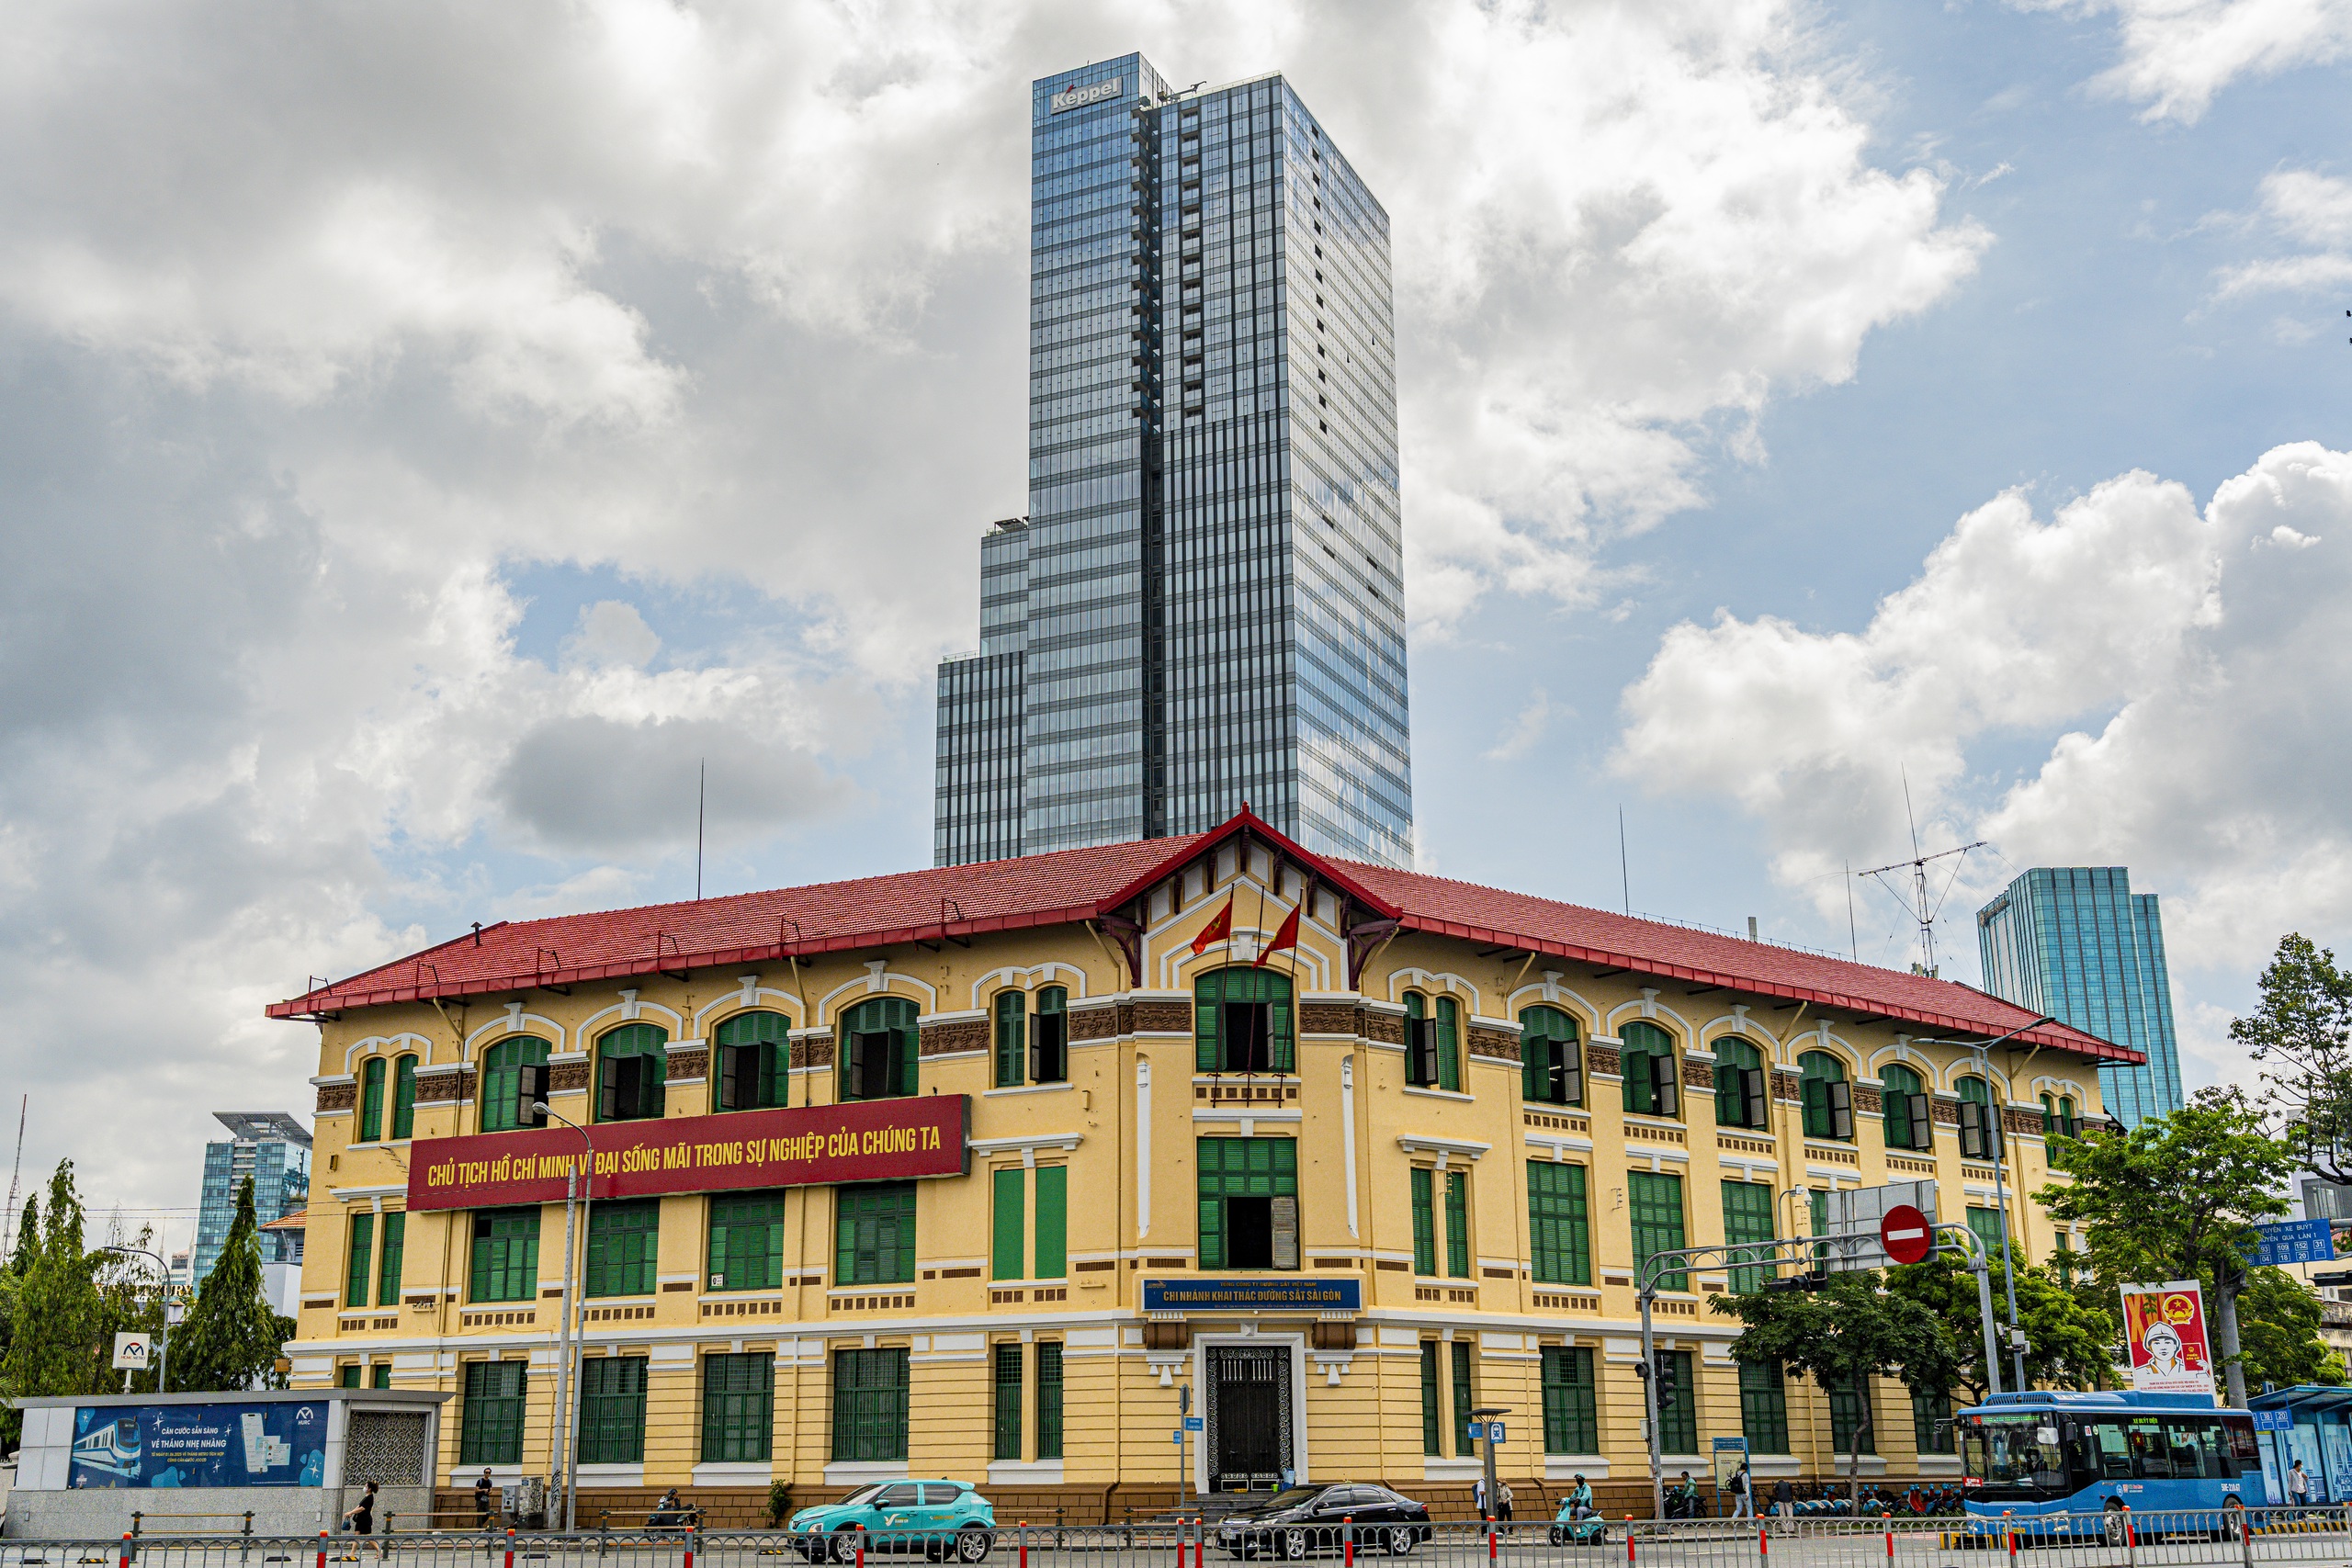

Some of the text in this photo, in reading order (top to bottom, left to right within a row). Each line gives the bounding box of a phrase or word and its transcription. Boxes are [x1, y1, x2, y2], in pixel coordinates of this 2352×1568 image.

[1053, 78, 1118, 109] Keppel
[428, 1157, 455, 1187] CHỦ
[458, 1162, 488, 1188] TỊCH
[491, 1155, 511, 1182] HỒ
[513, 1153, 537, 1180] CHÍ
[538, 1155, 575, 1179] MINH
[595, 1151, 619, 1179] ĐẠI
[622, 1143, 660, 1173] SỐNG
[663, 1142, 691, 1169] MÃI
[695, 1142, 742, 1168] TRONG
[746, 1138, 767, 1168] SỰ
[769, 1131, 825, 1164] NGHIỆP
[828, 1126, 859, 1157] CỦA
[863, 1125, 916, 1155] CHÚNG
[920, 1125, 941, 1150] TA
[2298, 1232, 2312, 1240] LÀN
[1163, 1288, 1341, 1302] CHI NHÁNH KHAI THÁC ĐƯỜNG SẮT SÀI GÒN
[152, 1438, 227, 1450] VÉ THÁNG NHẸ NHÀNG
